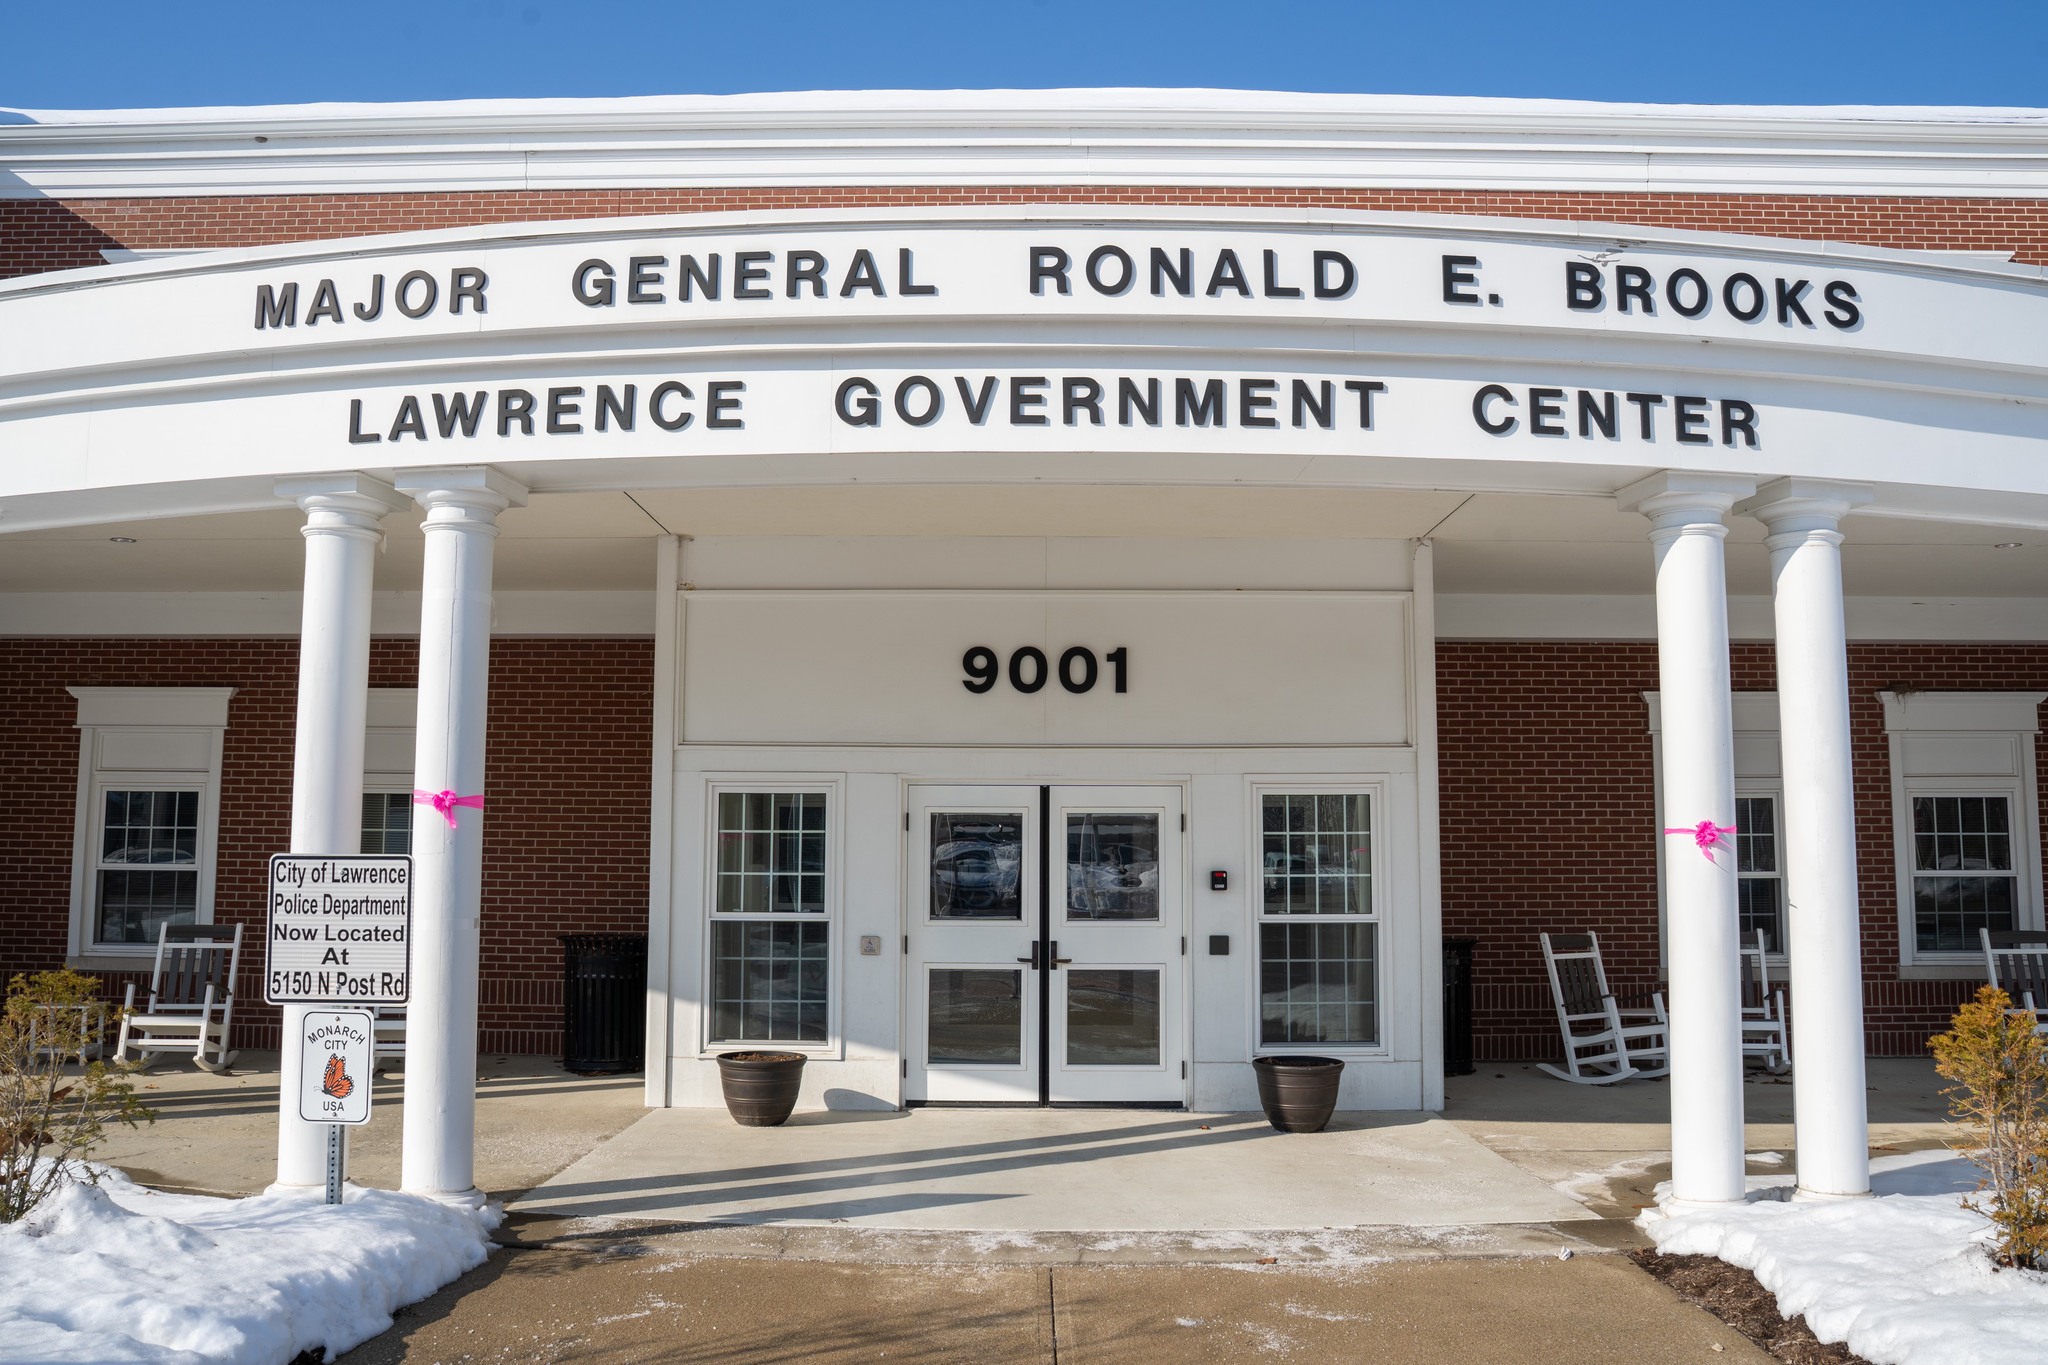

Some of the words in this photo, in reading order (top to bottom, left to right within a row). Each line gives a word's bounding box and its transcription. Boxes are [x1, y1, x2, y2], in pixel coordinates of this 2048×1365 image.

[254, 266, 487, 329] MAJOR
[571, 247, 936, 306] GENERAL
[1029, 244, 1358, 300] RONALD
[1441, 254, 1501, 305] E.
[1565, 260, 1861, 329] BROOKS
[348, 380, 744, 444] LAWRENCE
[833, 374, 1385, 429] GOVERNMENT
[1471, 383, 1759, 447] CENTER
[961, 645, 1128, 694] 9001
[275, 862, 306, 888] City
[311, 862, 327, 883] of
[331, 862, 406, 884] Lawrence
[274, 893, 318, 915] Police
[322, 894, 405, 920] Department
[273, 924, 318, 941] Now
[325, 925, 405, 942] Located
[321, 947, 349, 965] At
[271, 971, 311, 995] 5150
[318, 972, 330, 995] N
[336, 972, 376, 996] Post
[382, 973, 404, 996] Rd
[307, 1025, 365, 1044] MONARCH
[324, 1040, 348, 1050] CITY
[323, 1101, 344, 1111] USA
